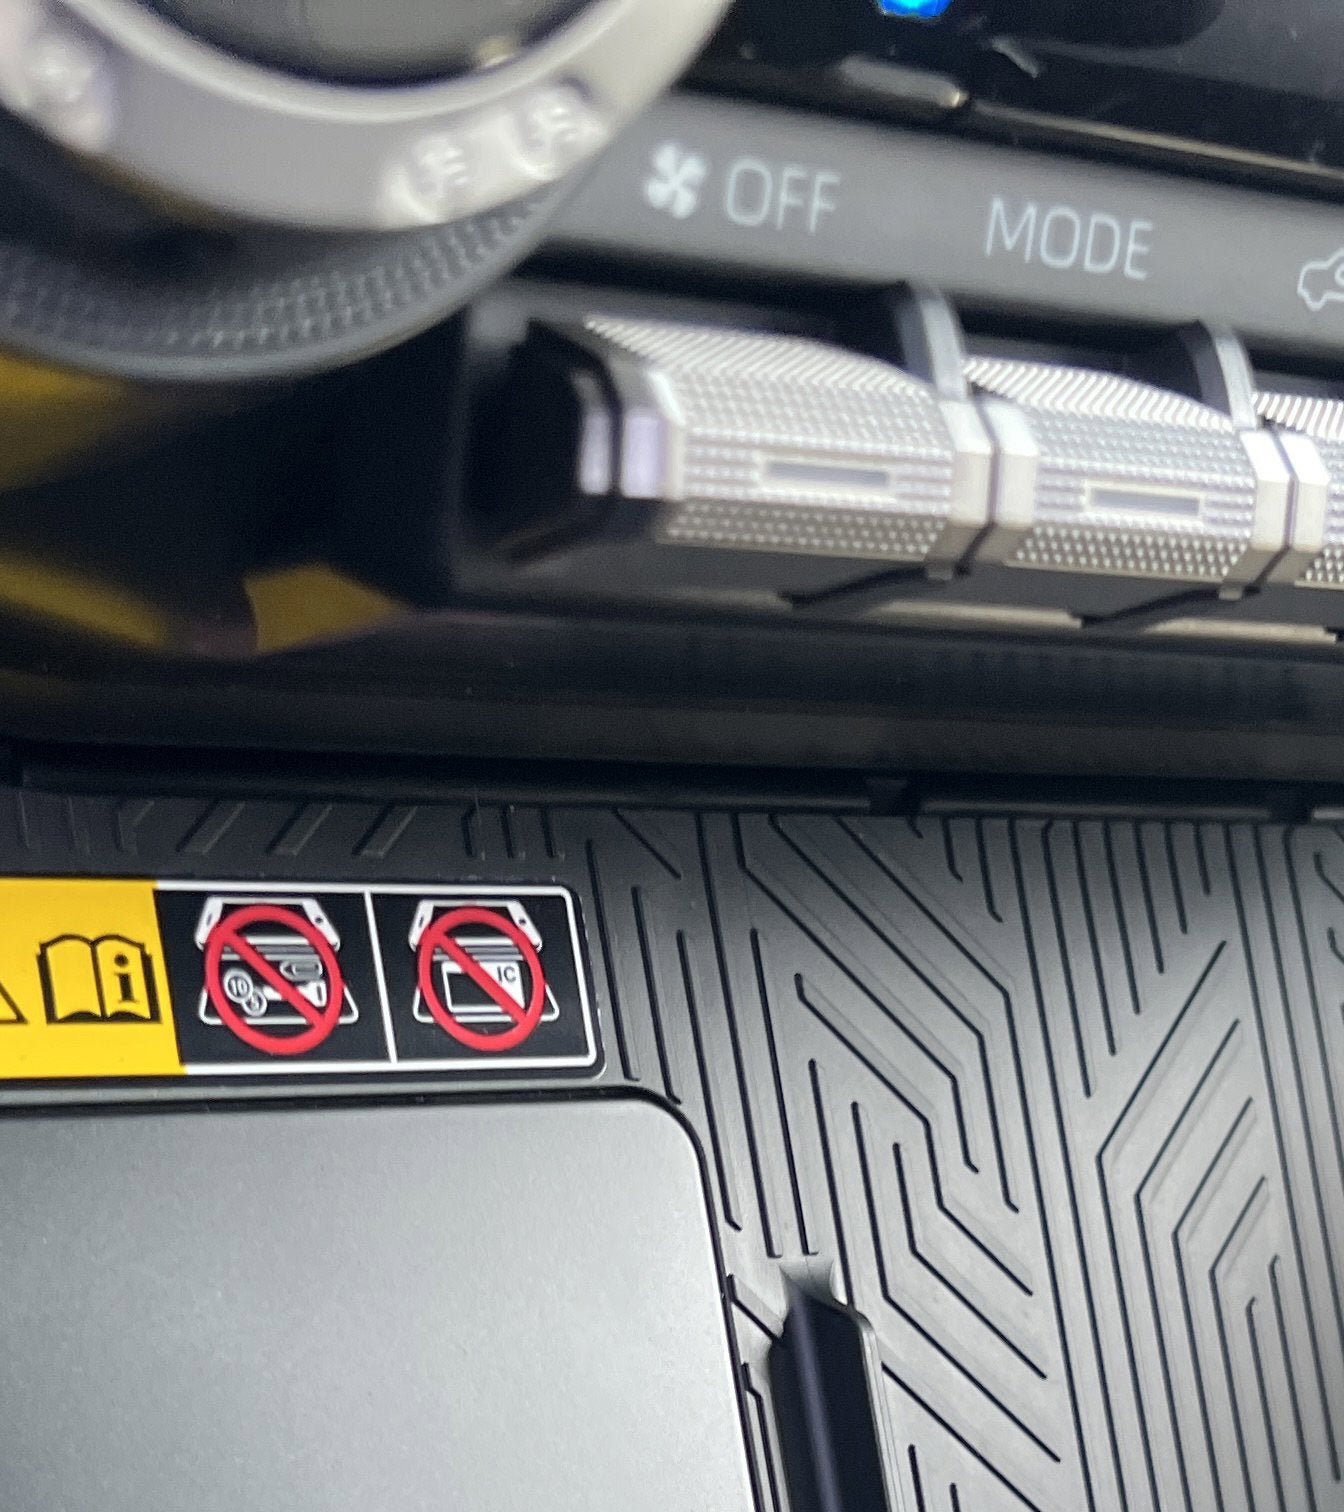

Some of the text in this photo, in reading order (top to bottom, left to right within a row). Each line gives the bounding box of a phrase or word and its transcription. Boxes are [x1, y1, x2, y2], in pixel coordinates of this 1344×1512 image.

[724, 155, 841, 233] OFF
[985, 195, 1154, 281] MODE
[496, 966, 517, 982] IC
